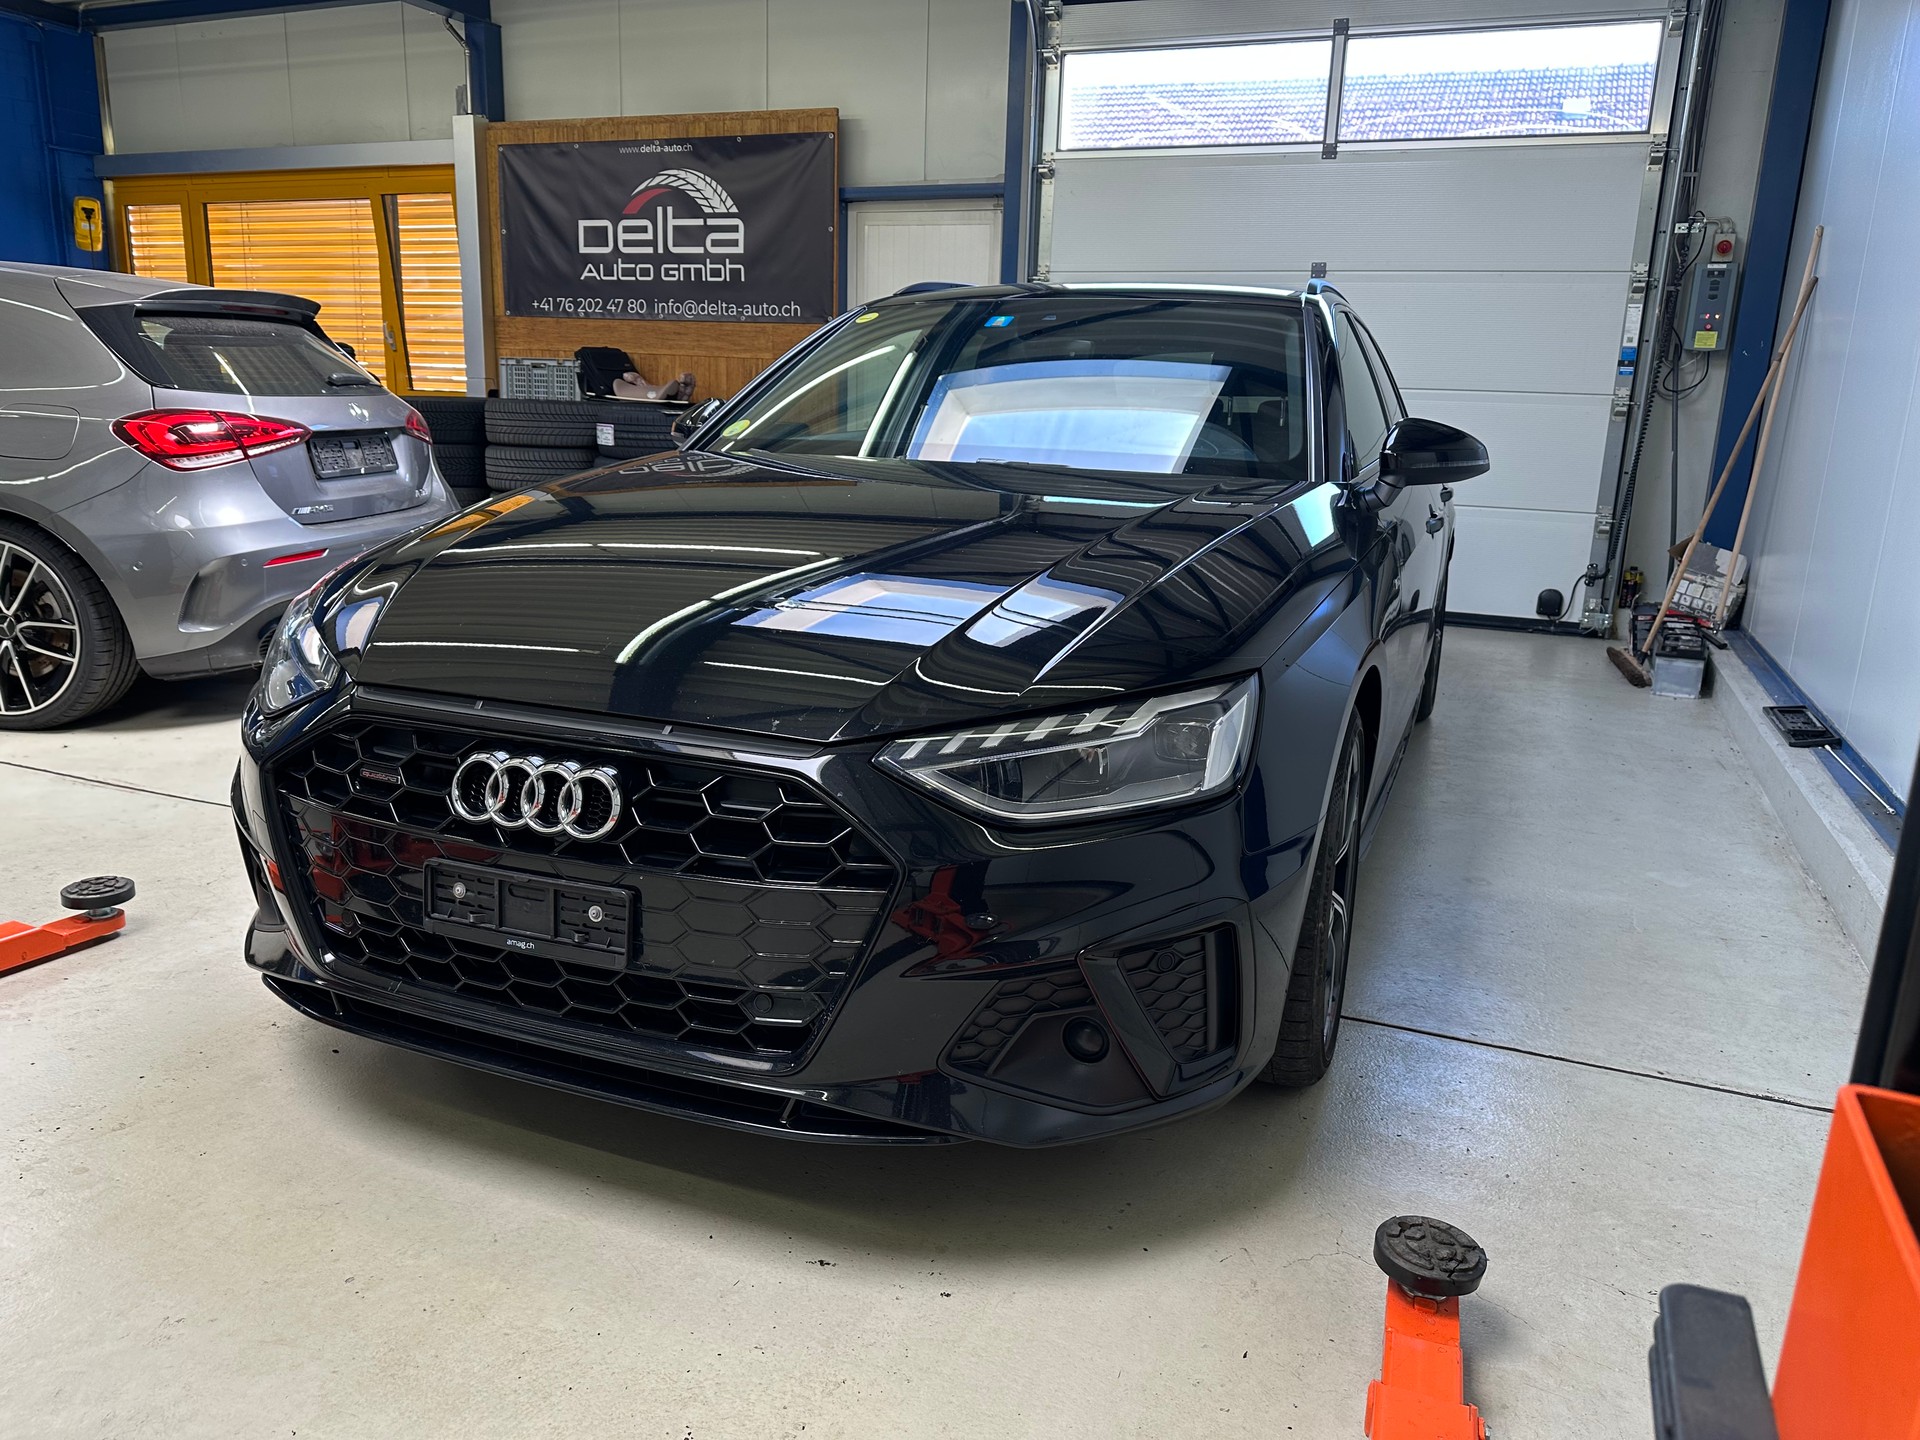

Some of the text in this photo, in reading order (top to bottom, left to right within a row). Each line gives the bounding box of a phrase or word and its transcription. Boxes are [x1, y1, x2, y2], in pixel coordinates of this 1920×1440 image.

[618, 143, 693, 154] www.delta-auto.ch
[580, 258, 654, 281] Auto
[532, 297, 801, 318] +41 76 202 47 80 info@delta-auto.ch
[506, 939, 535, 950] amag.ch
